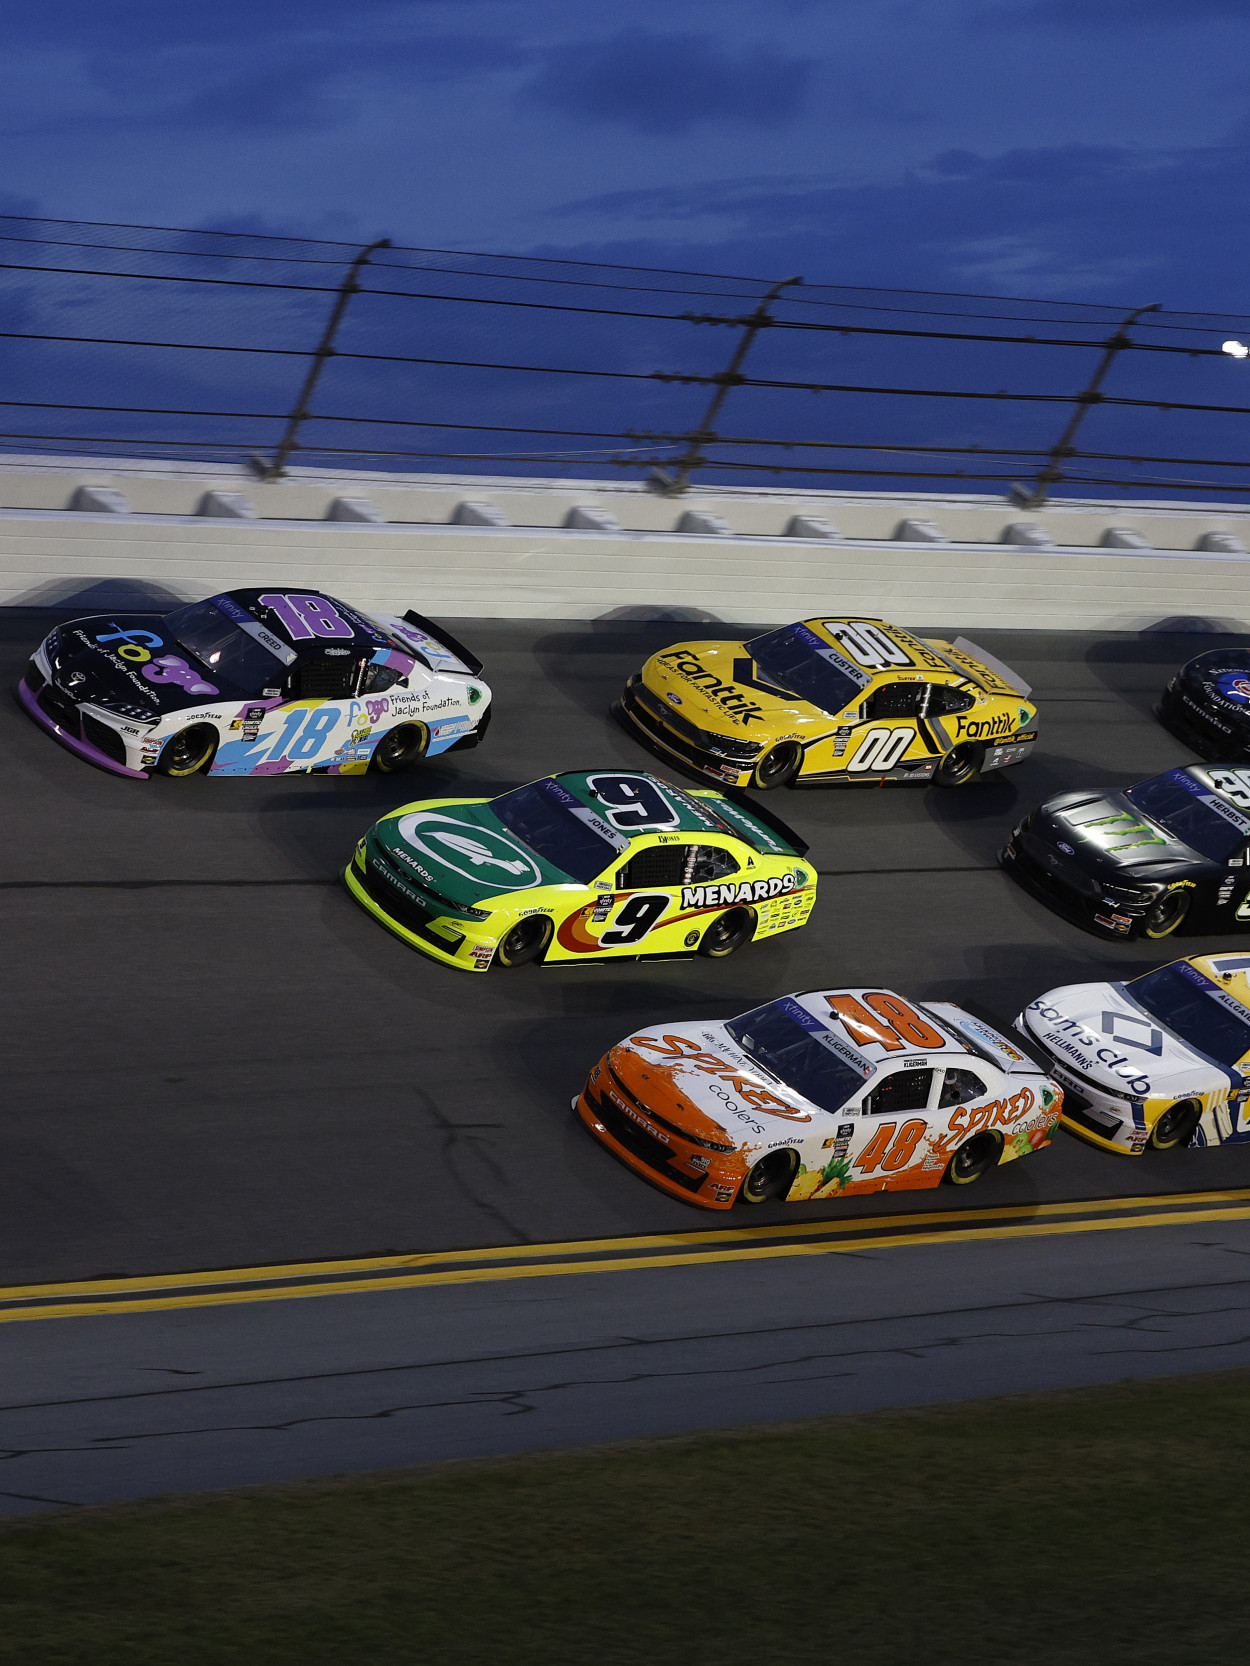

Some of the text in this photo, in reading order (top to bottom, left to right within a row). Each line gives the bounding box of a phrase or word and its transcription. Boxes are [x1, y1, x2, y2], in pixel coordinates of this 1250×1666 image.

[216, 597, 245, 619] xfinity
[257, 594, 355, 641] 18
[72, 629, 98, 651] Friends
[257, 631, 282, 650] CREED
[794, 625, 821, 648] xfinity
[822, 621, 915, 669] 00
[882, 624, 946, 668] Fanttik
[828, 653, 863, 680] CUSTER
[389, 690, 430, 706] Friends of
[660, 650, 766, 726] Fanttik
[676, 671, 693, 683] FOR
[690, 682, 726, 713] FANTASTIC
[724, 710, 741, 725] LIFE
[391, 703, 420, 717] Jaclyn
[955, 713, 1016, 738] Fanttik
[1182, 695, 1233, 735] CAMARO
[269, 707, 341, 761] 18
[846, 727, 917, 773] 00
[544, 781, 574, 804] xfinity
[1173, 772, 1201, 792] xfinity
[585, 774, 681, 831] 9
[647, 775, 714, 828] MENARDS
[1210, 799, 1247, 826] HERBST
[588, 817, 617, 840] JONES
[372, 858, 427, 908] CAMARO
[393, 847, 434, 883] MENARDS
[681, 874, 796, 910] MENARDS
[598, 891, 673, 948] 9
[1178, 964, 1209, 986] xfinity
[783, 1001, 816, 1027] xfinity
[823, 992, 946, 1052] 48
[822, 1033, 868, 1075] KLIGERMAN
[1043, 1032, 1093, 1071] HELLMANN'S
[1053, 1069, 1085, 1094] ARO
[609, 1090, 670, 1144] CAMARO
[709, 1084, 766, 1134] coolers
[933, 1086, 1035, 1152] SPIKED
[1011, 1111, 1059, 1136] coolers
[768, 1137, 805, 1149] GOODYEAR
[852, 1118, 928, 1174] 48
[709, 1183, 735, 1193] ARP
